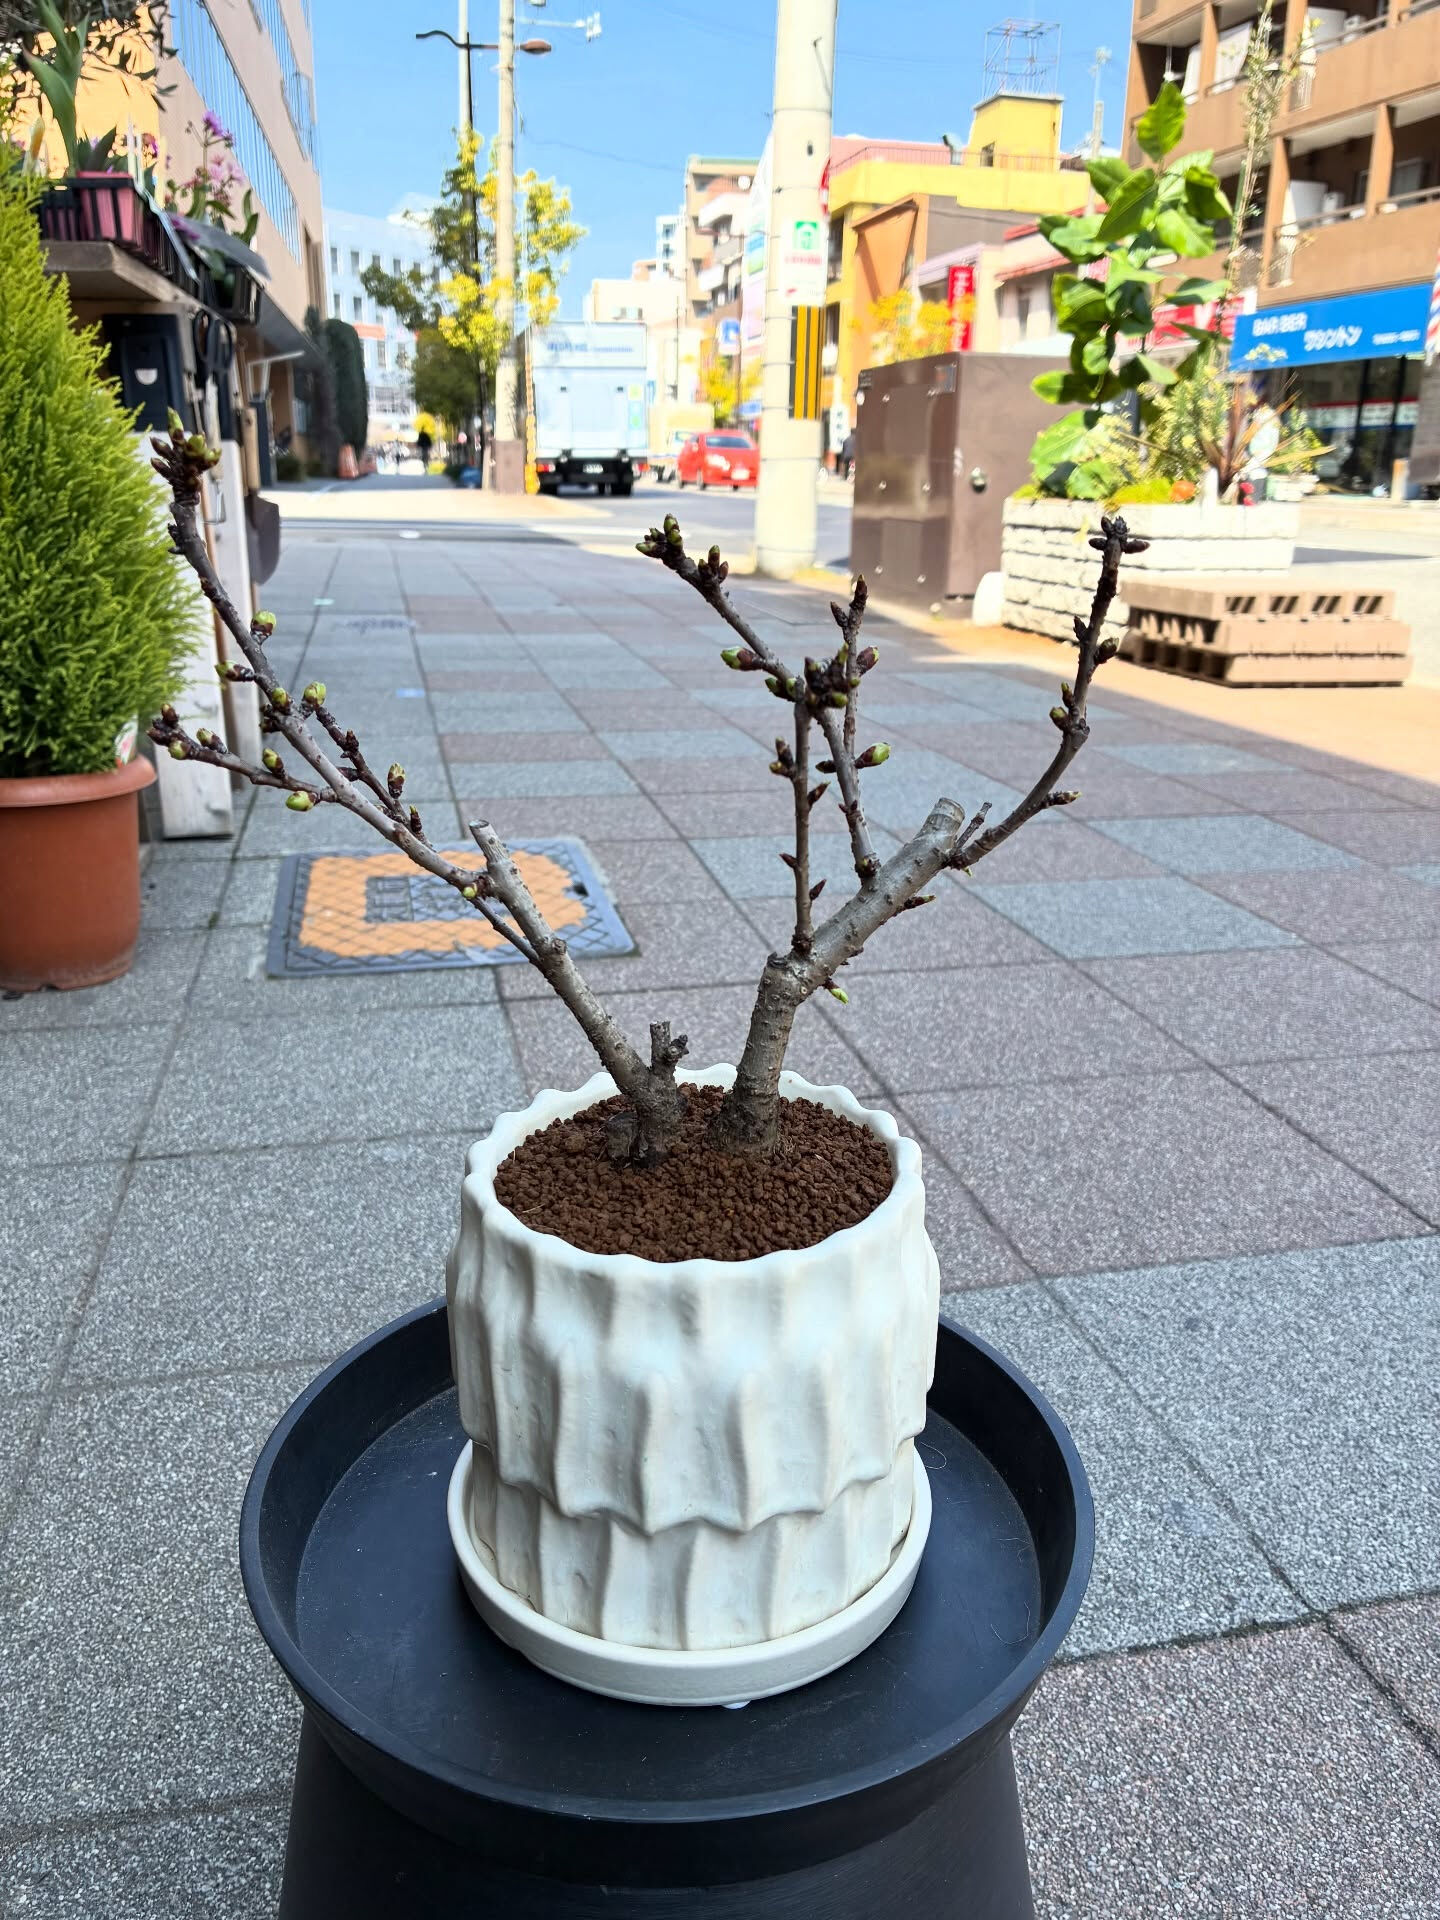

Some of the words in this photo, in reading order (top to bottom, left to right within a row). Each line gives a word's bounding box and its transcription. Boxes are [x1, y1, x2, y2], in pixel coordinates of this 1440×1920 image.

[1303, 325, 1363, 352] ワシントン
